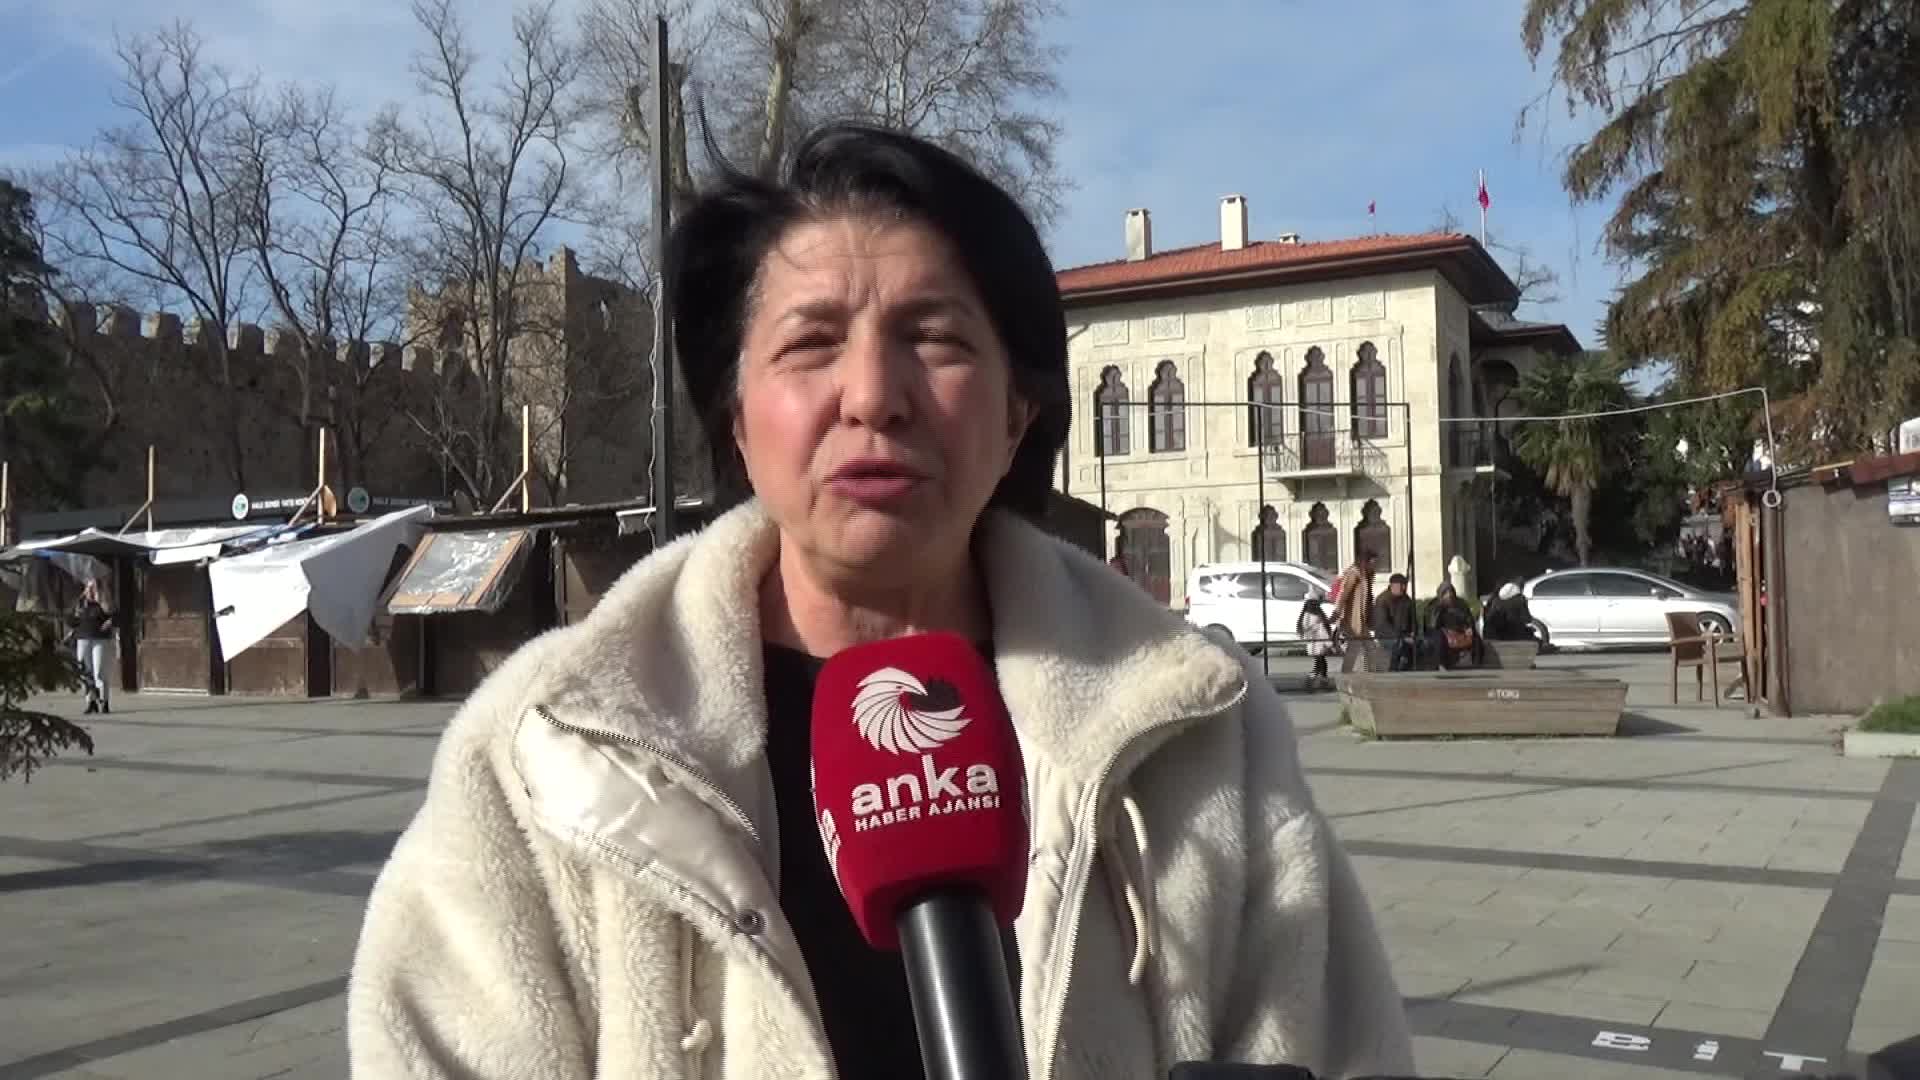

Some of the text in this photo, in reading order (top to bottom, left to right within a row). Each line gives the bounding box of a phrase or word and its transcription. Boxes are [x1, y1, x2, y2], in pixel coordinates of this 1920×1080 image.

[851, 754, 1000, 816] anka
[855, 796, 1001, 832] HABER AJANSI
